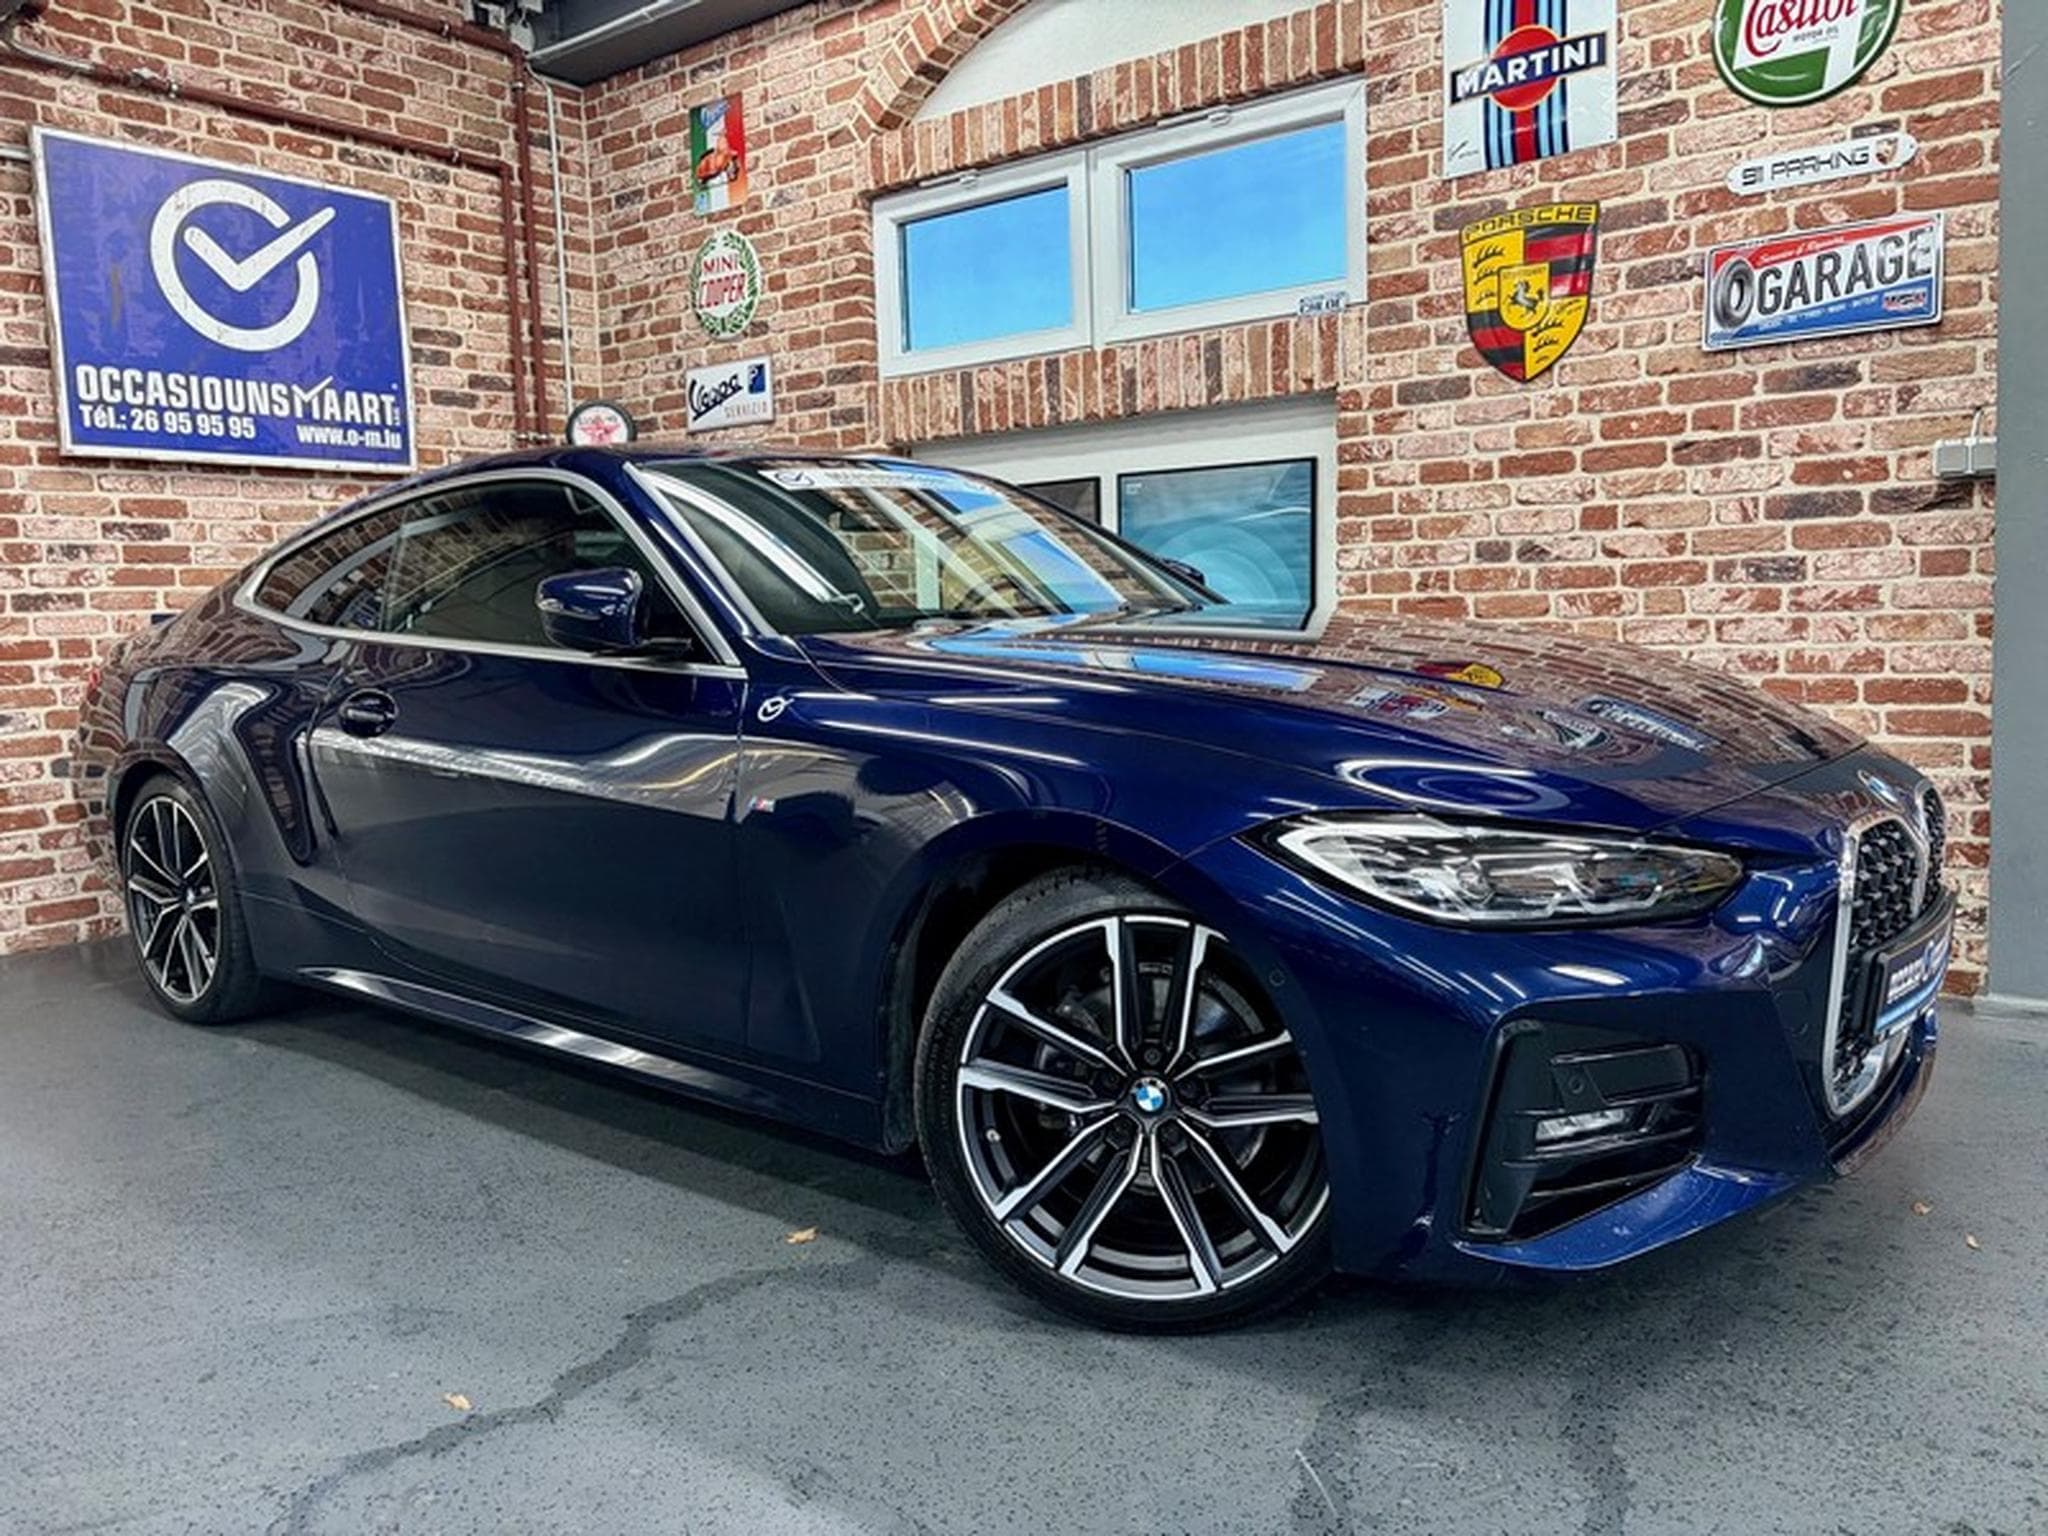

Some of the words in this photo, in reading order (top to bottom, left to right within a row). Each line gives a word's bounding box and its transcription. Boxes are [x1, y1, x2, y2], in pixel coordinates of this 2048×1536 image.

[1456, 38, 1598, 98] MARTINI
[1770, 146, 1870, 181] PARKING
[1465, 206, 1593, 242] PORSCHE
[703, 253, 739, 274] MINI
[1757, 225, 1933, 316] GARAGE
[76, 364, 396, 426] OCCASIOUNSMAART
[689, 373, 744, 421] Vespa
[130, 408, 160, 432] 26
[163, 411, 193, 434] 95
[196, 413, 225, 437] 95
[228, 415, 256, 439] 95
[296, 423, 402, 450] www.o-m.lu
